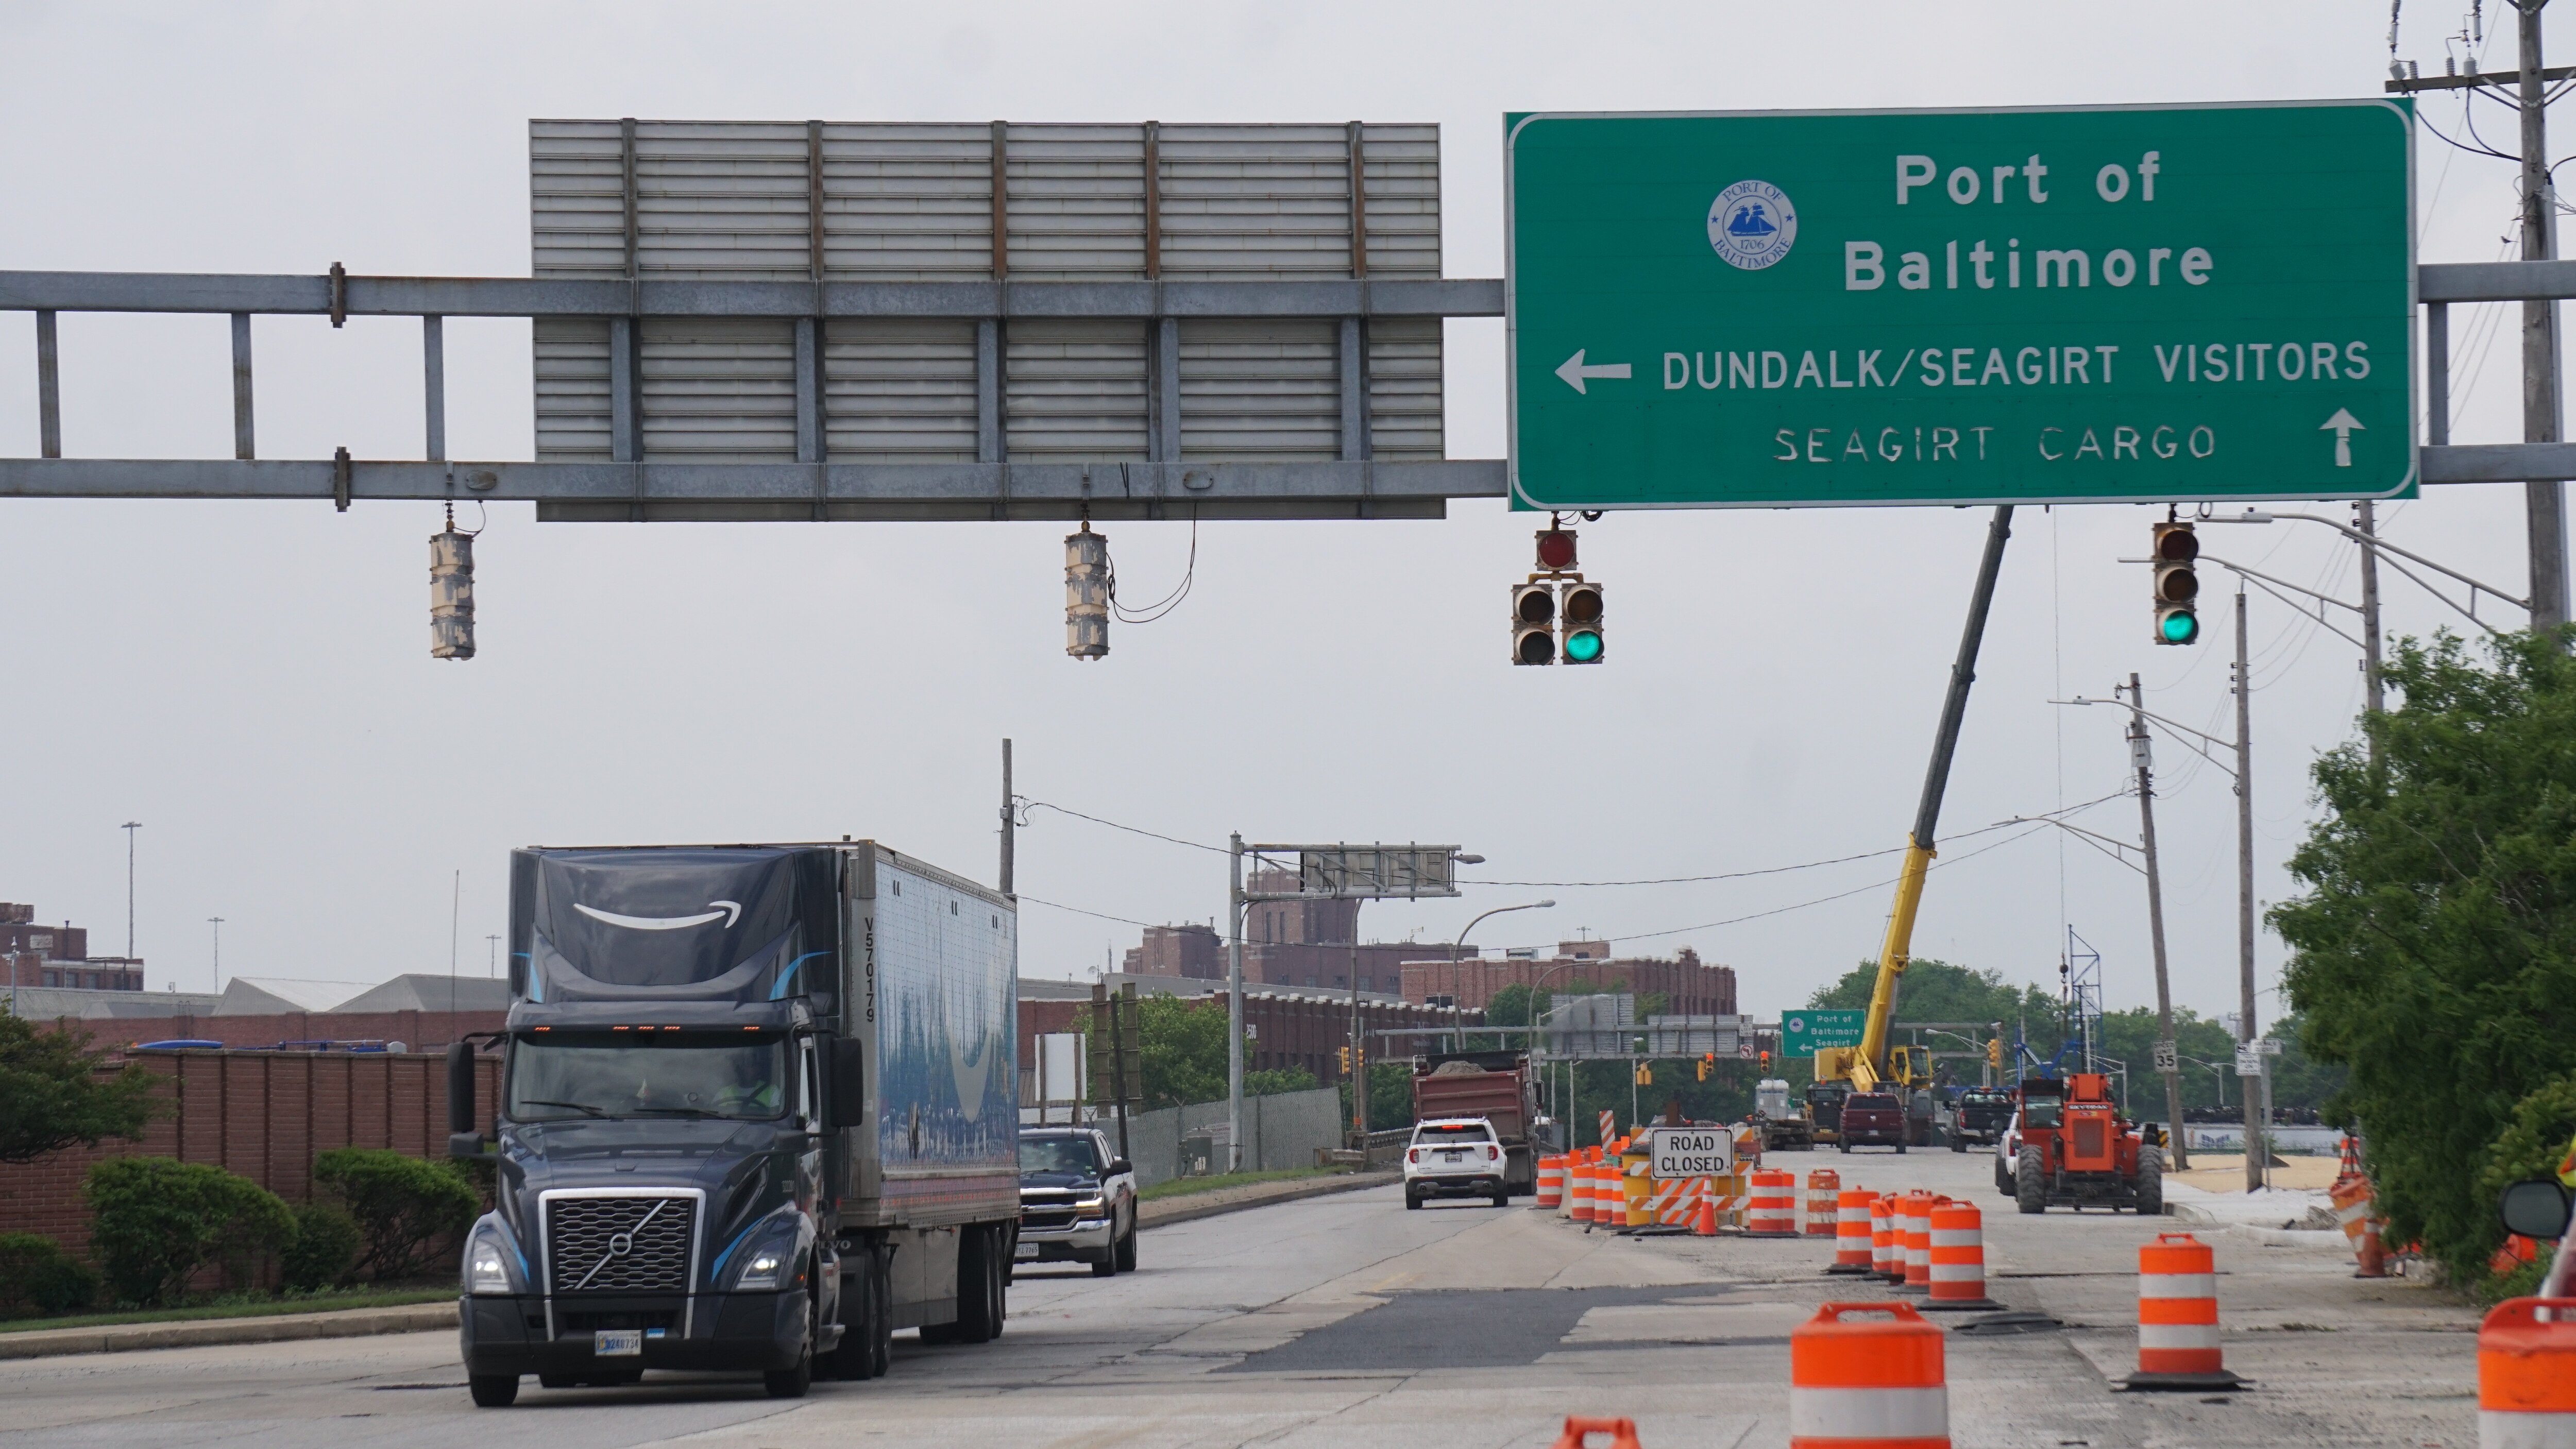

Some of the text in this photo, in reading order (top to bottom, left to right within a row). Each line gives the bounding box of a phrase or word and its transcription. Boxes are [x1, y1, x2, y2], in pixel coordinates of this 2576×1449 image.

[1896, 151, 2159, 204] Port of
[1722, 182, 1784, 202] PORT OF
[1714, 237, 1791, 268] BALTIMORE
[1740, 240, 1765, 250] 1706
[1845, 238, 2213, 291] Baltimore
[1664, 340, 2370, 389] DUNDALK/SEAGIRT VISITORS
[1775, 425, 2214, 462] SEAGIRT CARGO
[865, 917, 874, 1022] V570179
[1816, 1039, 1851, 1047] Seagirt
[2157, 1055, 2174, 1067] 35
[1670, 1136, 1714, 1150] ROAD
[1662, 1157, 1724, 1171] CLOSED
